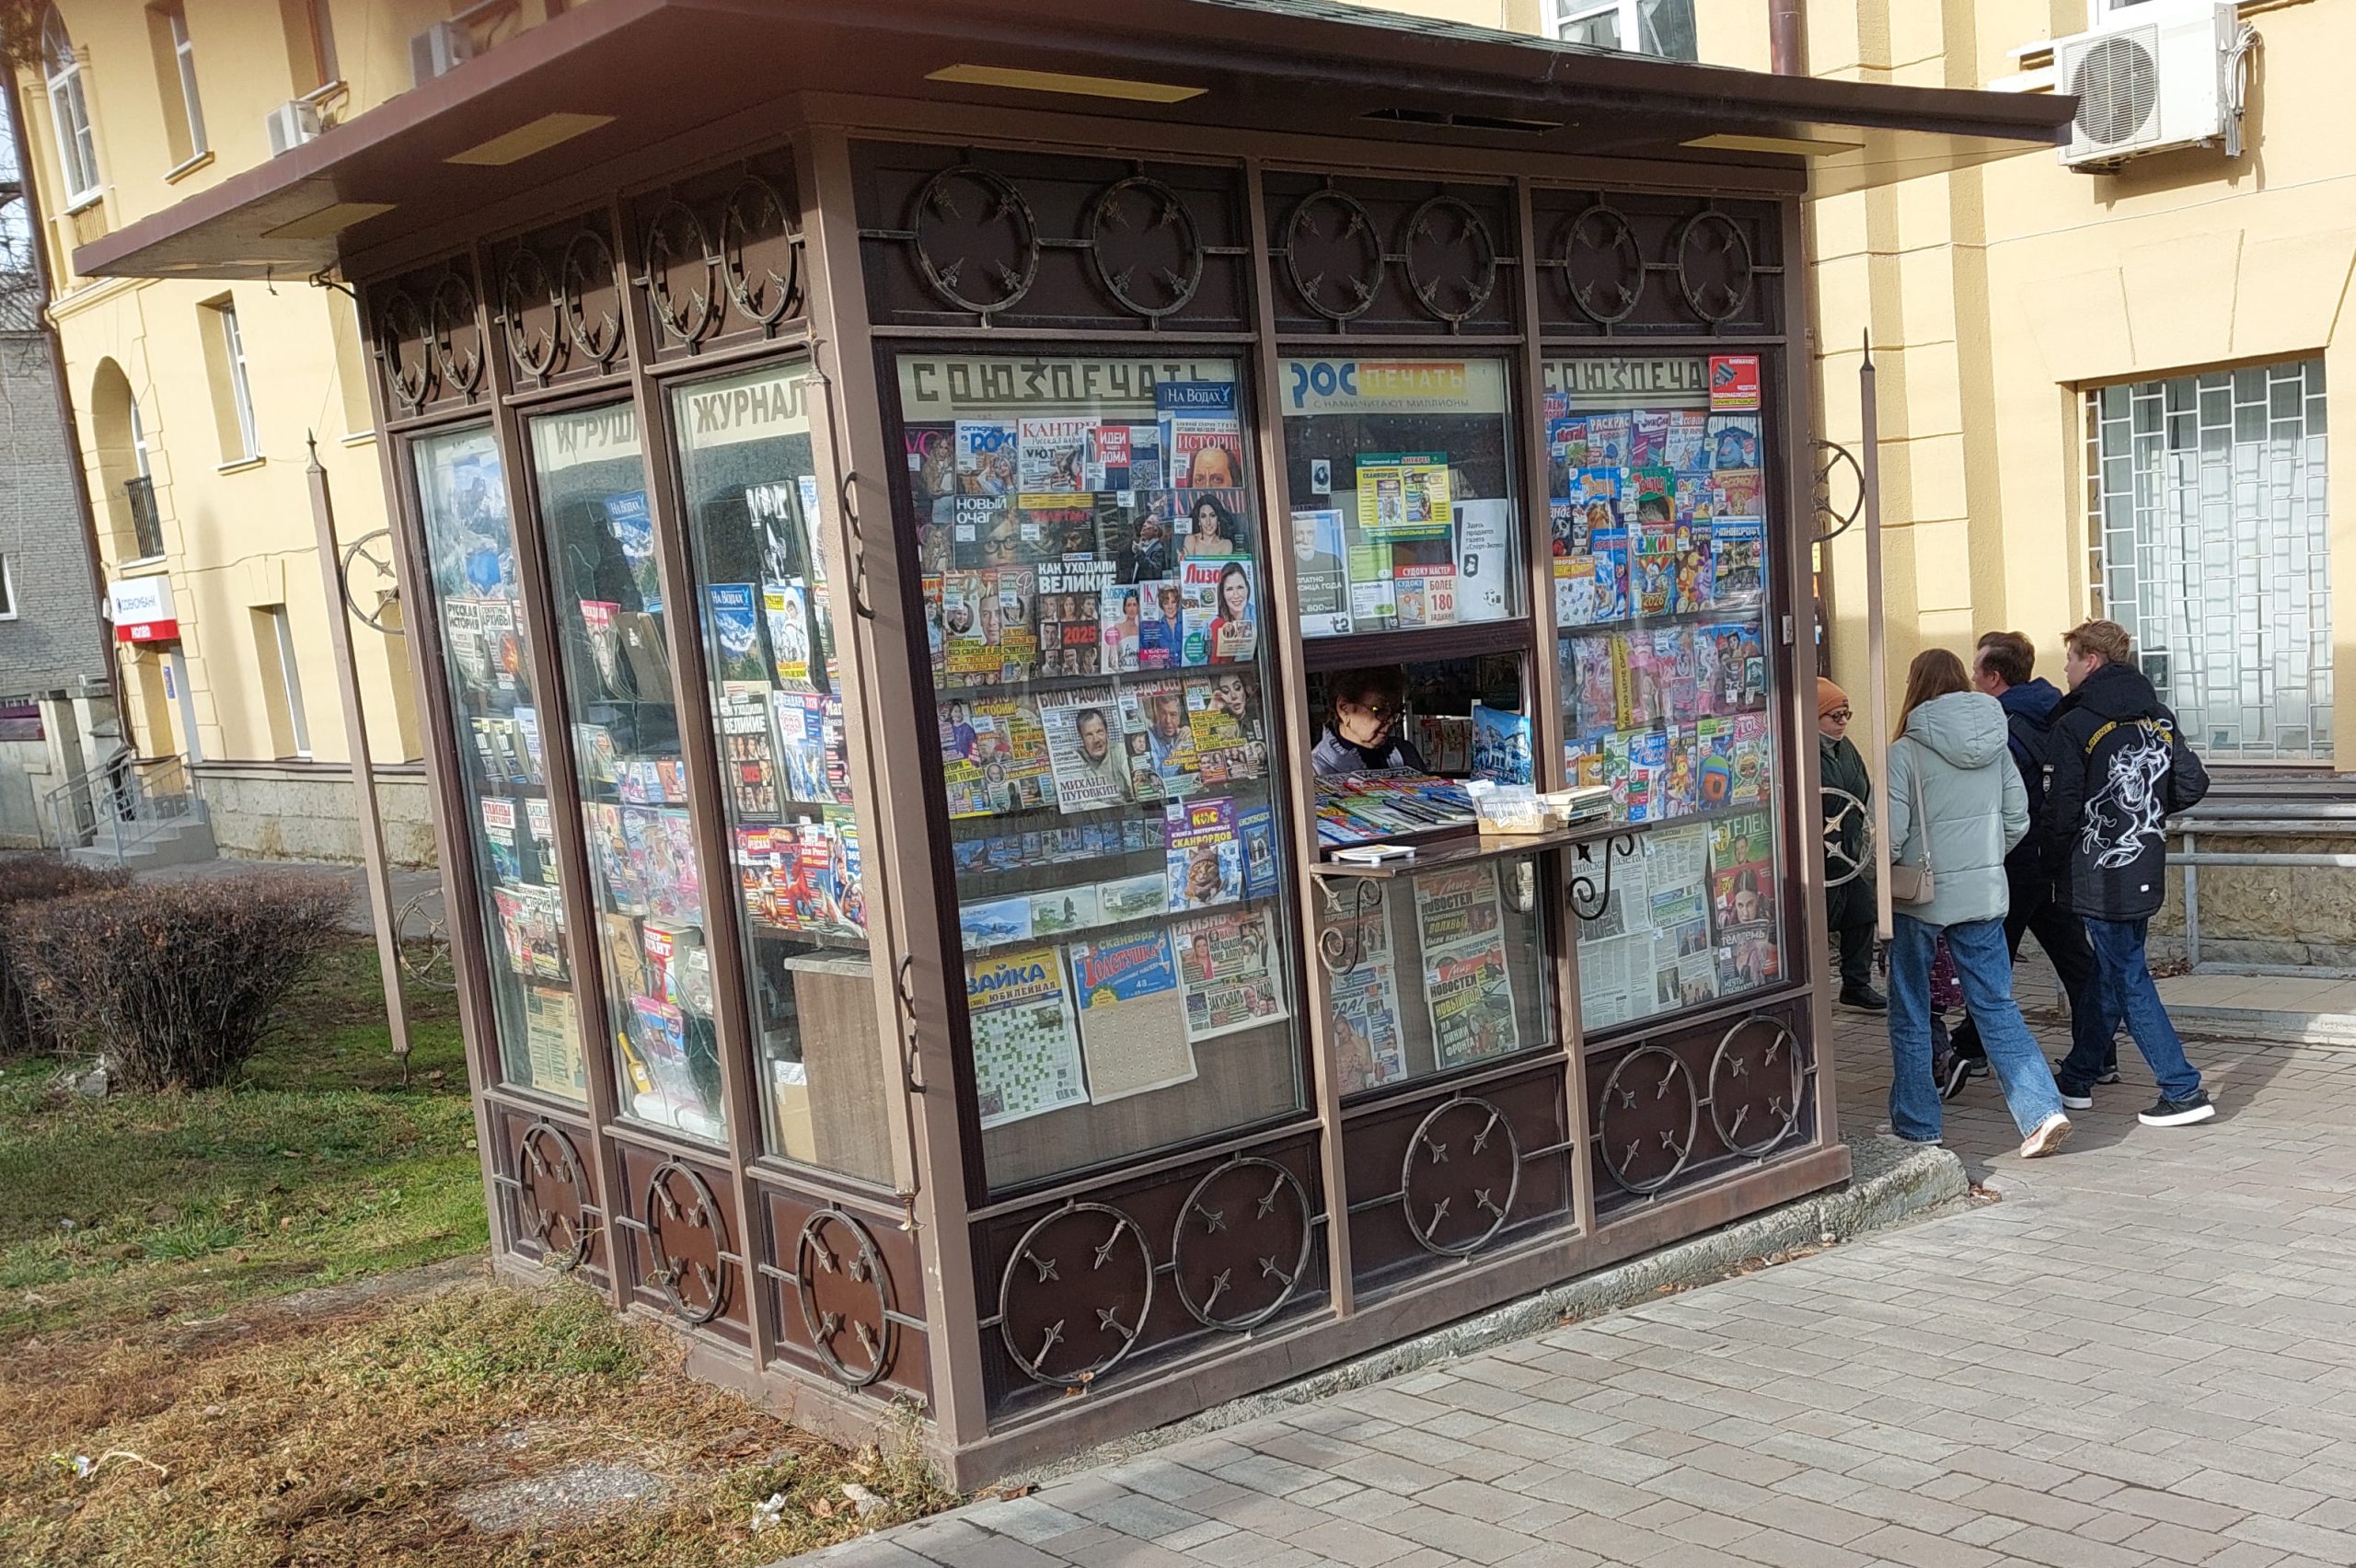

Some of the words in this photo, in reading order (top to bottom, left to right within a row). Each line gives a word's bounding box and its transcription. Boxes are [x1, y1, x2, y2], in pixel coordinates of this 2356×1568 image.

[1290, 362, 1357, 409] РОС
[1366, 369, 1465, 390] ПЕЧАТЬ
[693, 378, 809, 434] ЖУРНАЛ
[1323, 400, 1357, 409] НАМИ
[1358, 399, 1403, 409] ЧИТАЮТ
[1406, 398, 1470, 408] МИЛЛИОНЫ
[554, 410, 641, 455] ИГРУШ
[1100, 432, 1126, 445] ИДЕИ
[1100, 450, 1128, 465] ДОМА
[956, 496, 1007, 511] НОВЫЙ
[956, 512, 993, 525] очаг
[1038, 562, 1063, 575] КАК
[1065, 560, 1117, 576] УХОДИЛИ
[1184, 562, 1222, 584] Лиза
[1403, 568, 1428, 577] СУДОКУ
[1429, 566, 1451, 575] МАСТЕР
[1038, 574, 1118, 594] ВЕЛИКИЕ
[1322, 581, 1343, 590] ГОДА
[1397, 580, 1424, 588] СУДОКУ
[1429, 579, 1453, 591] БОЛЕЕ
[1431, 594, 1453, 611] 180
[1643, 594, 1665, 607] 2026
[447, 603, 479, 617] РУССКАЯ
[448, 617, 479, 630] ИСТОРИЯ
[481, 614, 511, 627] АРХИВЫ
[1064, 627, 1095, 644] 2025
[1621, 674, 1631, 698] ЦЕНЕ
[722, 715, 767, 734] ВЕЛИКИЕ
[1059, 774, 1106, 791] МИХАИЛ
[1060, 785, 1119, 802] ПУГОВКИН
[1172, 831, 1232, 848] СКАНВОРДОВ
[521, 894, 553, 911] ИСТОРИЯ
[967, 963, 1047, 996] ЗАЙКА
[1429, 972, 1478, 998] НОВОСТЕЙ
[987, 980, 1057, 1004] ЮБИЛЕЙНАЯ
[1207, 989, 1244, 1012] ЗАКУСЫВАТЬ
[1435, 992, 1464, 1018] НОВЫЙ
[1446, 1034, 1475, 1057] ФРОНТА
